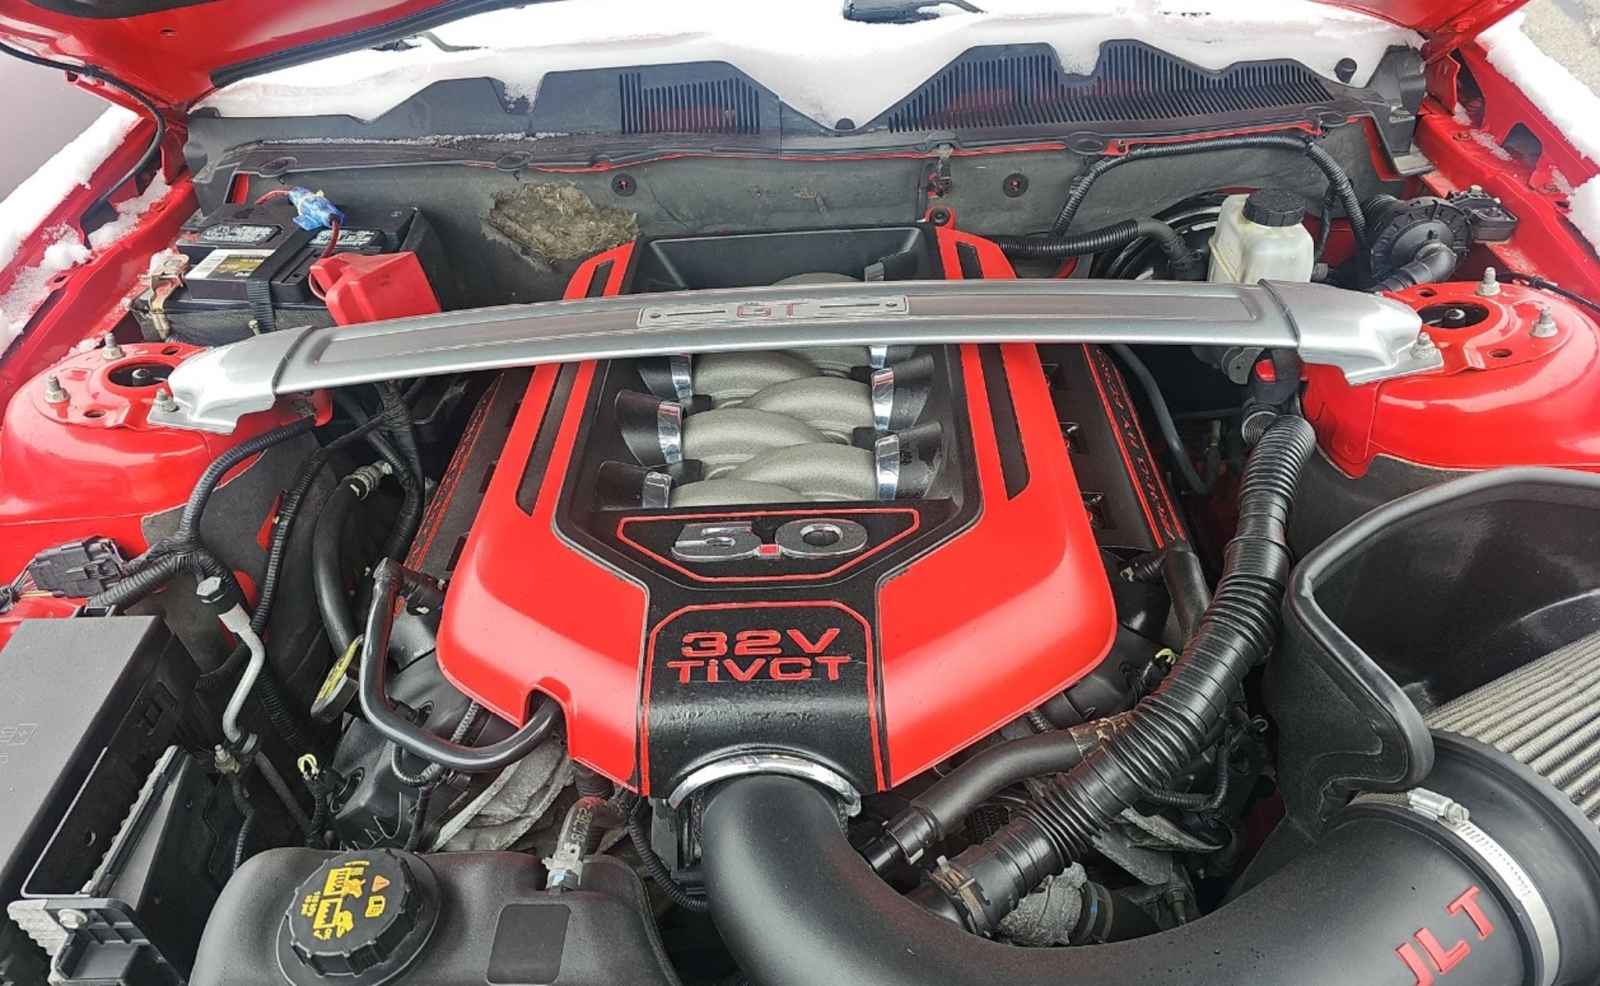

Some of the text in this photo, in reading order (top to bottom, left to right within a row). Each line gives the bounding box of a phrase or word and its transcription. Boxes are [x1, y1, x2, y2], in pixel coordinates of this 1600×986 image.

[735, 301, 809, 319] GT
[671, 518, 868, 561] 5.0
[681, 627, 840, 657] 32V
[666, 655, 851, 684] TiVCT
[1395, 885, 1494, 986] JLT
